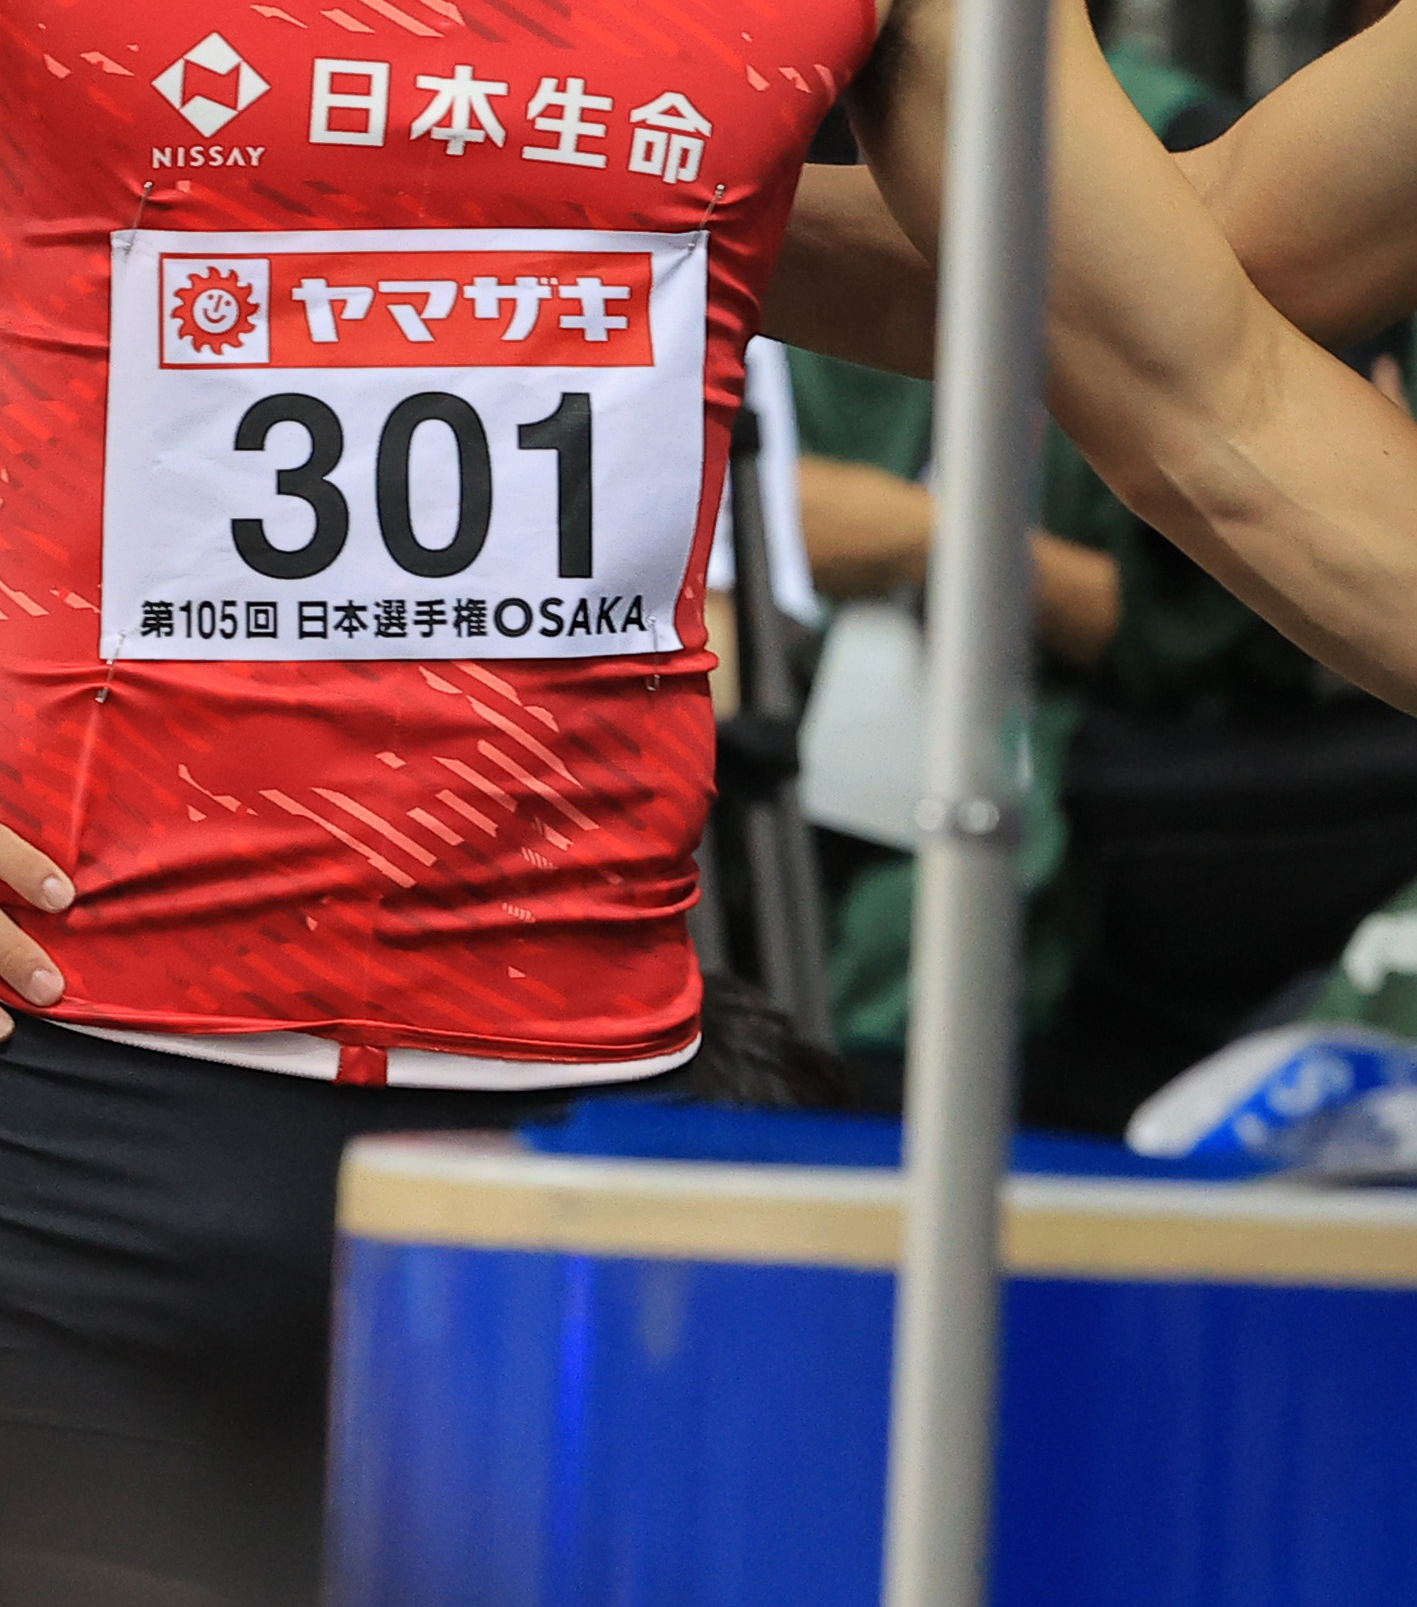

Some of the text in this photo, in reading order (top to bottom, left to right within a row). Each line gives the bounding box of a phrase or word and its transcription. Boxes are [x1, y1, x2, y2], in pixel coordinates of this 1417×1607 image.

[308, 57, 712, 185] 日本生命
[151, 146, 266, 169] NISSAY
[291, 275, 631, 343] ヤマザキ
[231, 391, 594, 580] 301
[139, 599, 279, 639] 第105回
